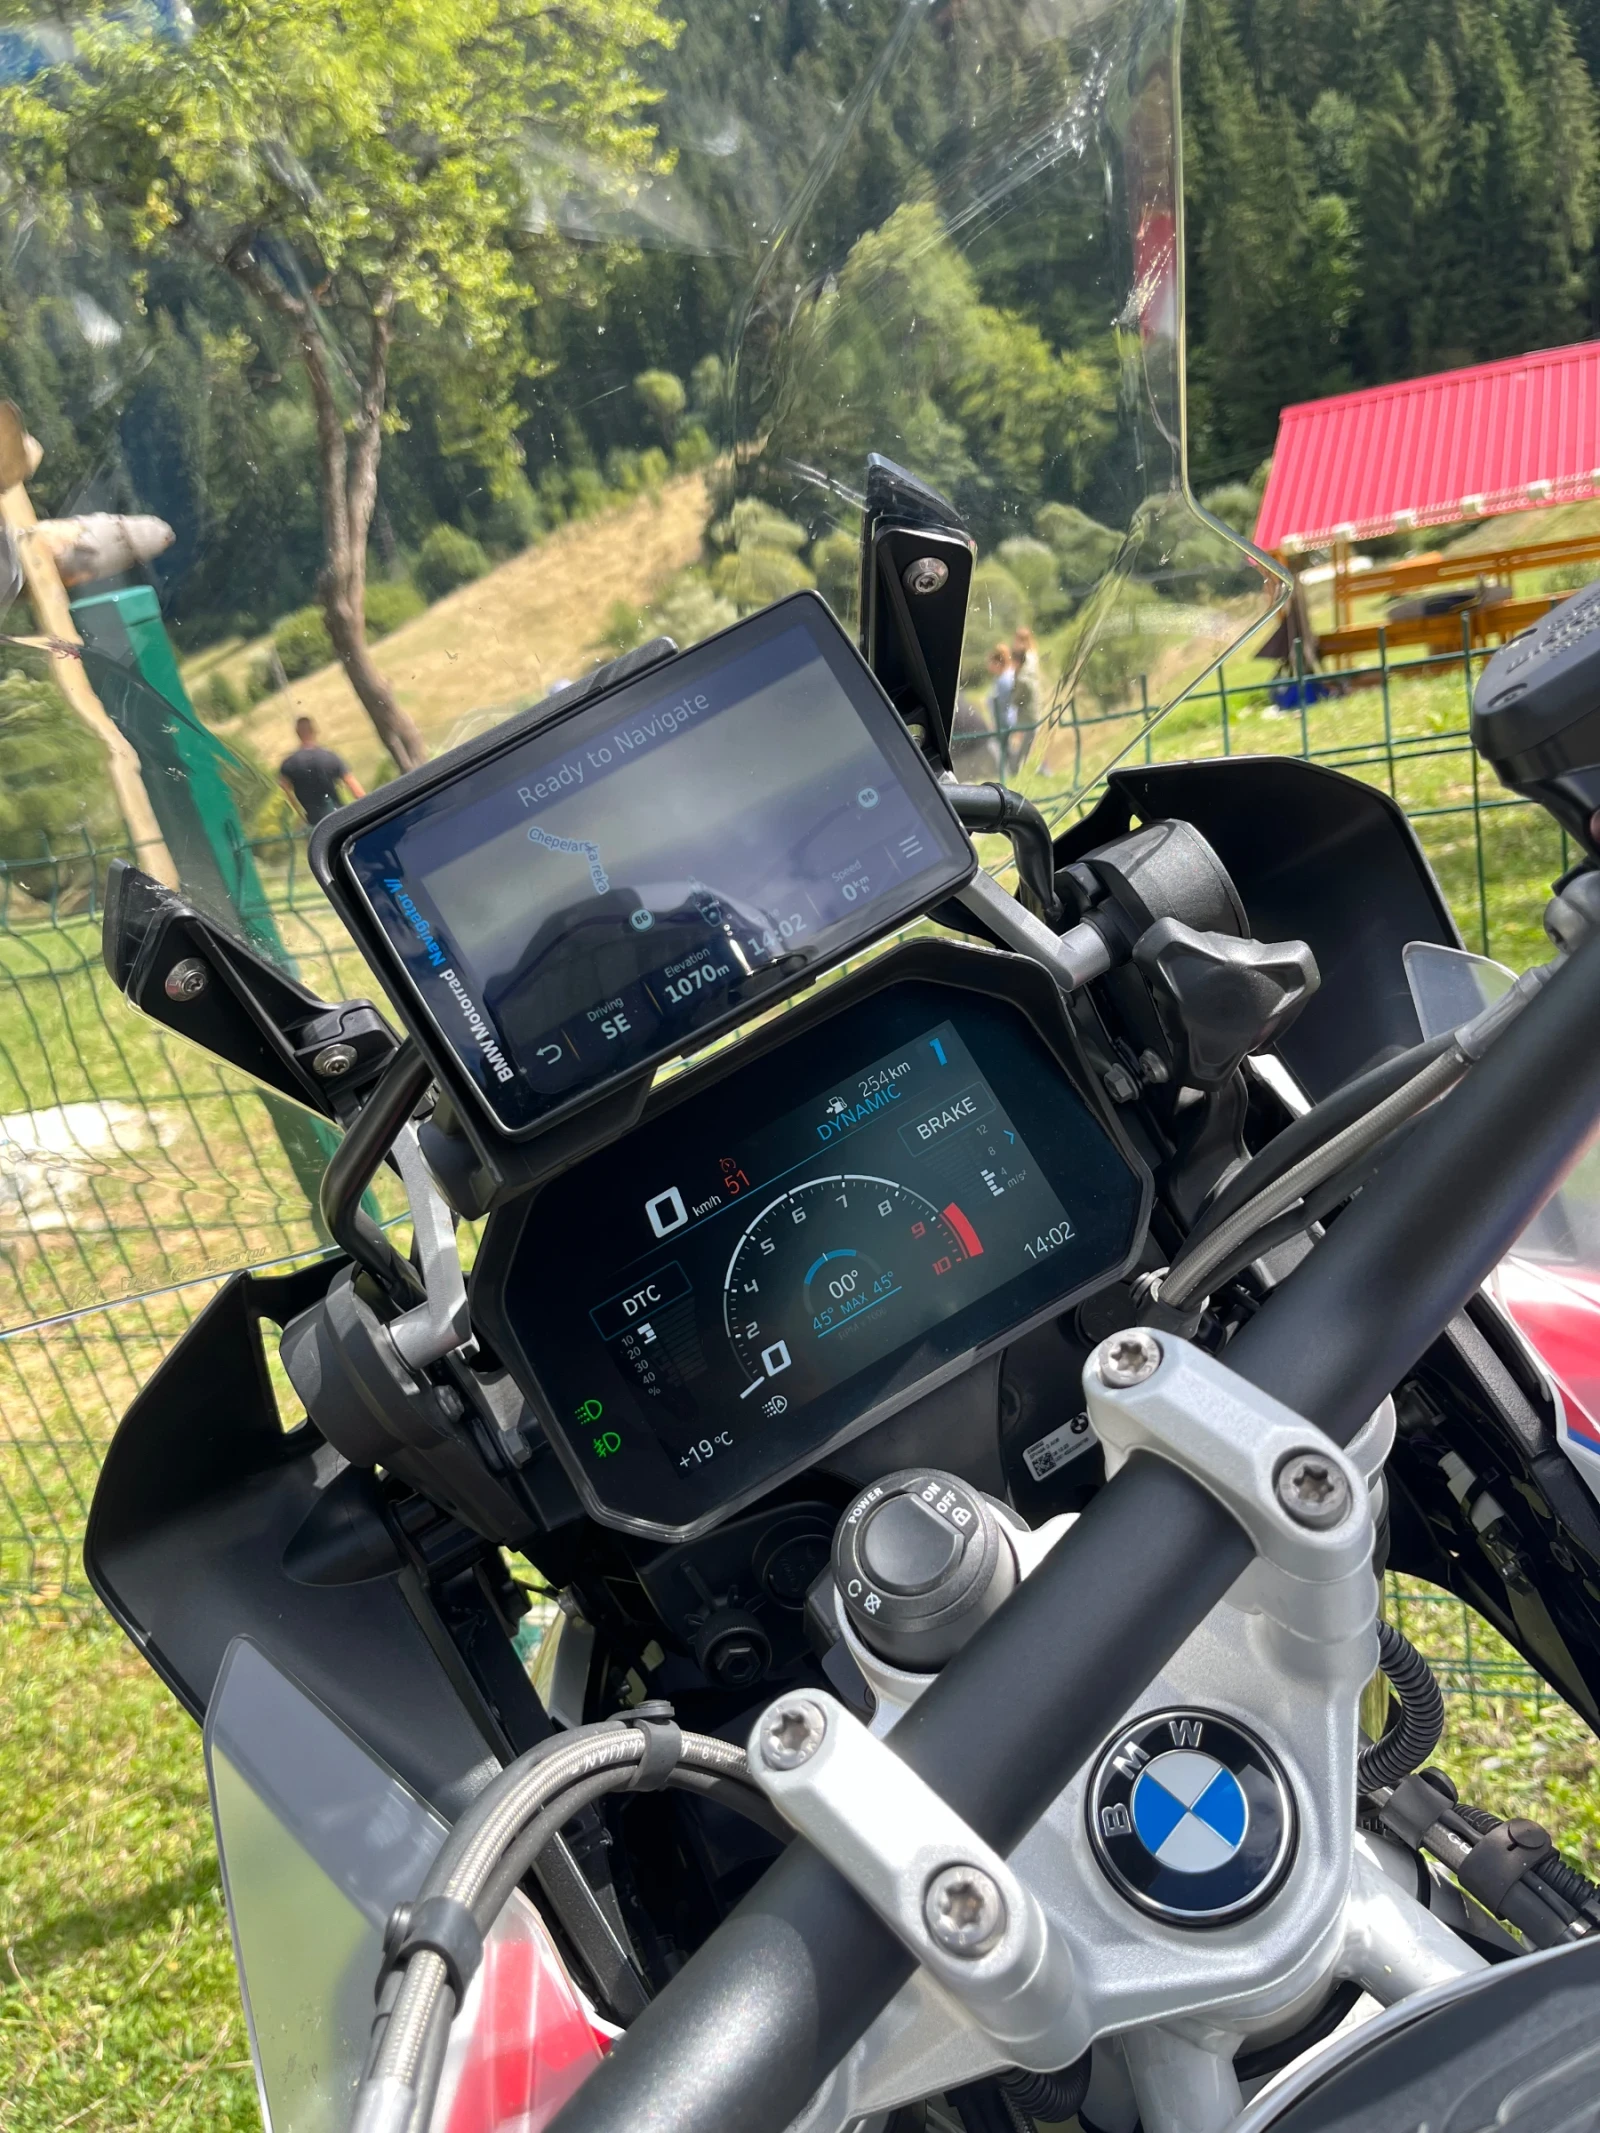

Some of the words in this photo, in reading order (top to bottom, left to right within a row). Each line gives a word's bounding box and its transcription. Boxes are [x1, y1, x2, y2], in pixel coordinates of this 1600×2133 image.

[517, 762, 584, 807] Ready
[587, 748, 612, 768] to
[613, 694, 709, 753] Navigate
[528, 828, 599, 861] Chepelarska
[591, 864, 608, 893] reka
[831, 859, 862, 883] Speed
[841, 883, 857, 901] 0
[398, 893, 446, 967] Navigator
[634, 912, 649, 925] 86
[748, 913, 807, 956] 14:02
[664, 948, 711, 979] Elevation
[439, 969, 490, 1041] Motorrad
[586, 997, 625, 1022] Driving
[601, 1012, 632, 1040] SE
[480, 1040, 515, 1083] BMW
[929, 1037, 948, 1066] 1
[858, 1070, 889, 1098] 254
[887, 1061, 911, 1080] km
[816, 1083, 902, 1140] DYNAMIC
[916, 1096, 977, 1140] BRAKE
[976, 1124, 989, 1136] 12
[987, 1146, 996, 1156] 8
[724, 1169, 750, 1194] 51
[1000, 1167, 1008, 1176] 4
[645, 1186, 689, 1239] 0
[692, 1194, 722, 1217] km/h
[835, 1194, 848, 1208] 7
[877, 1199, 892, 1217] 8
[791, 1206, 806, 1225] 6
[911, 1221, 926, 1239] 9
[1024, 1221, 1076, 1259] 14:02
[760, 1237, 776, 1256] 5
[932, 1256, 952, 1276] 10
[743, 1279, 760, 1293] 4
[622, 1284, 662, 1316] DTC
[840, 1291, 869, 1315] MAX
[621, 1335, 635, 1348] 10
[745, 1321, 761, 1340] 2
[627, 1346, 641, 1361] 20
[634, 1359, 649, 1373] 30
[760, 1339, 792, 1377] 0
[642, 1372, 656, 1385] 40
[921, 1482, 941, 1502] ON
[936, 1489, 958, 1514] OFF
[848, 1487, 884, 1524] POWER
[1101, 1719, 1203, 1837] BMW
